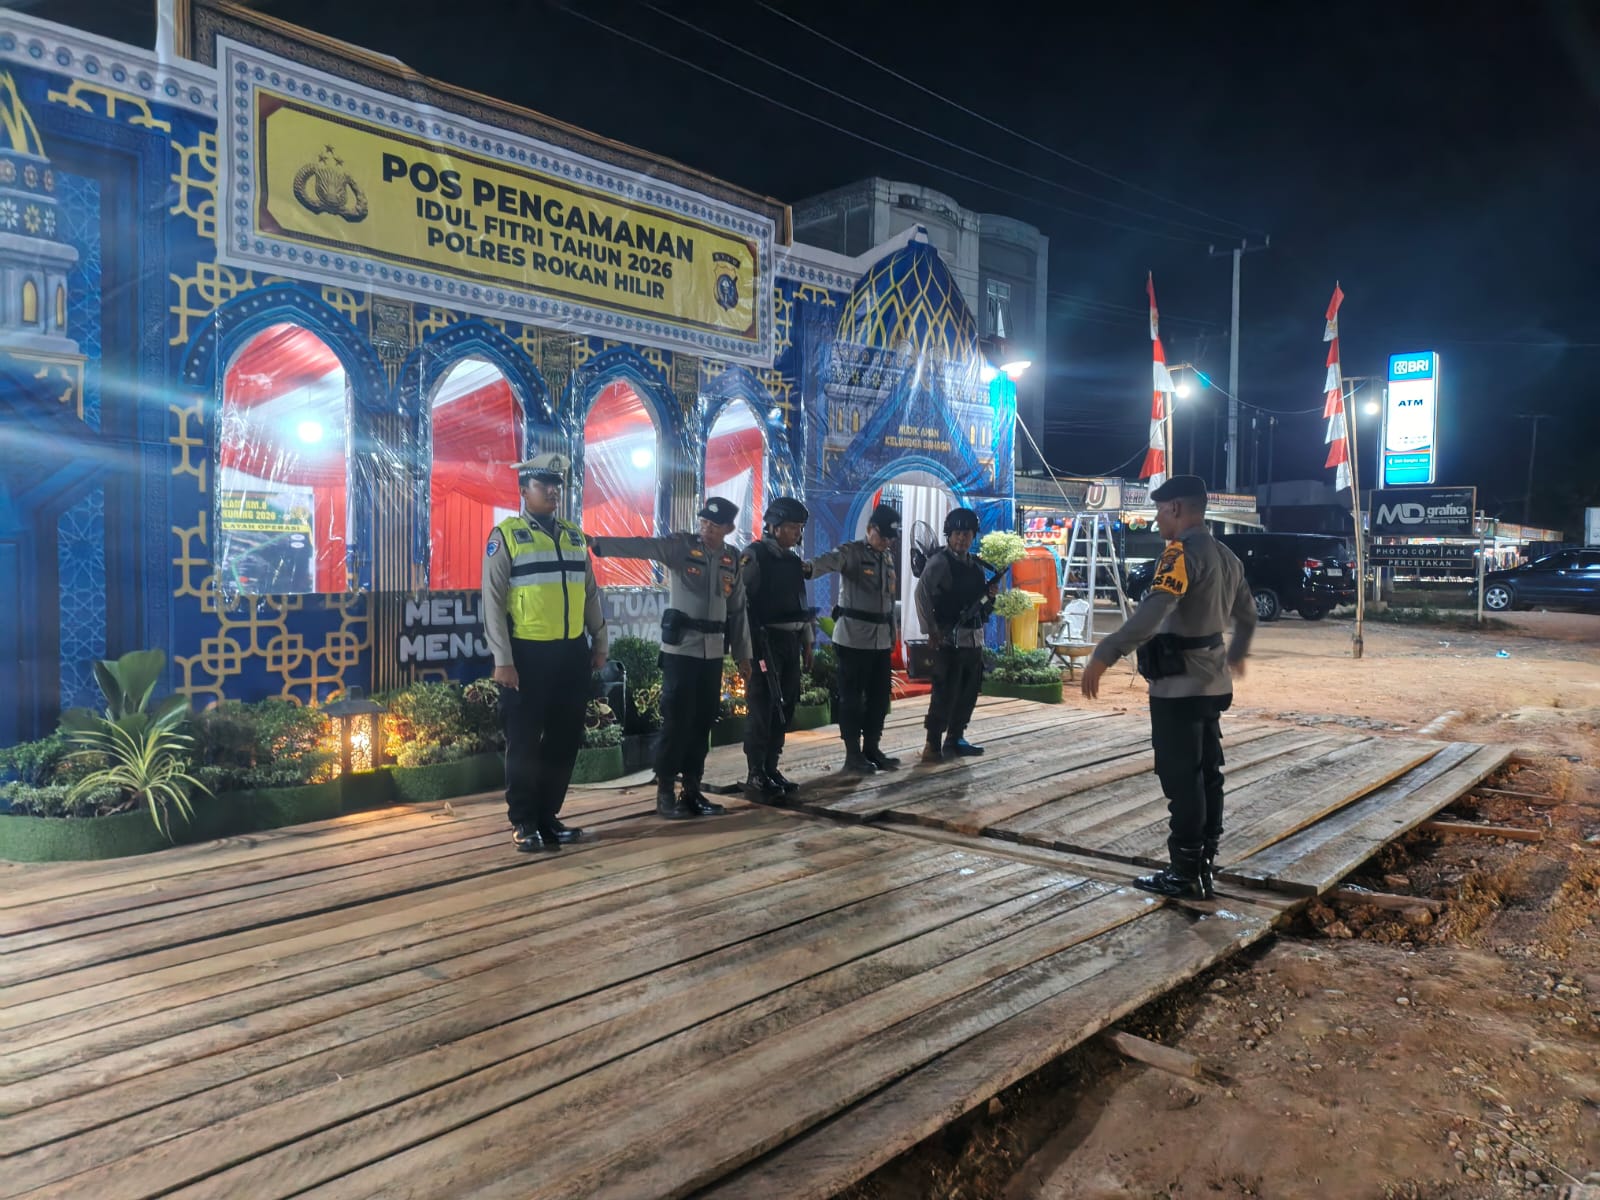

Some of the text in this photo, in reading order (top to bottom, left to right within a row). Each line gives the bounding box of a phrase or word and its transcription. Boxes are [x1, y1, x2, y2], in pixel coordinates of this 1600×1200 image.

[383, 152, 694, 263] POS PENGAMANAN
[416, 197, 673, 279] IDUL FITRI TAHUN 2026
[428, 227, 665, 299] POLRES ROKAN HILIR
[1408, 360, 1429, 373] BRI
[1398, 399, 1423, 407] ATM
[1427, 503, 1467, 518] grafika
[1446, 548, 1465, 556] ATK
